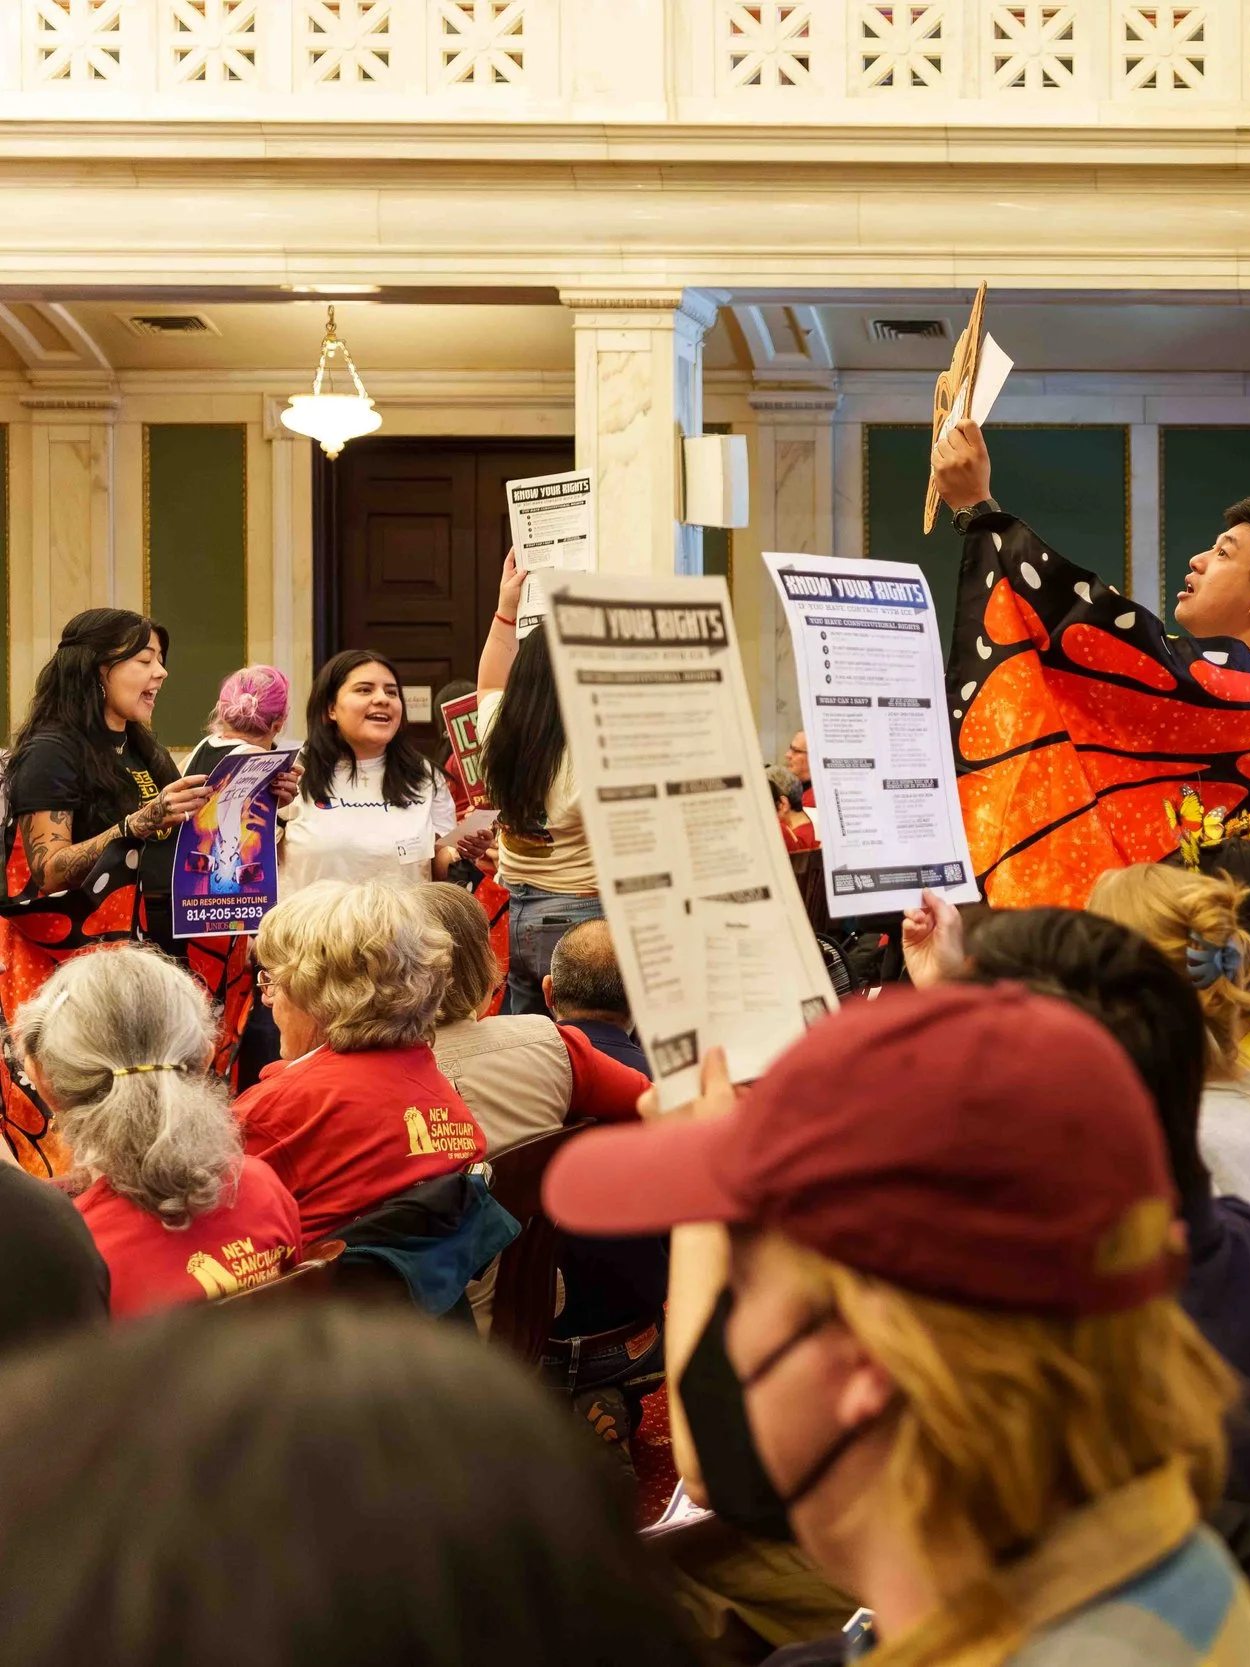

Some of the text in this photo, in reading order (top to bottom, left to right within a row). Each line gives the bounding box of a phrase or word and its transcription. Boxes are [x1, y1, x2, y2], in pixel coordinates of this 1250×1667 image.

[513, 479, 589, 502] KNOW YOUR RIGHTS
[783, 574, 924, 603] KNOW YOUR RIGHTS
[609, 608, 655, 640] YOUR
[655, 608, 725, 640] RIGHTS
[843, 619, 897, 630] CONSTITUTIONAL
[897, 623, 921, 631] RIGHTS
[217, 787, 250, 804] ICE
[182, 895, 268, 907] RAID RESPONSE HOTLINE
[186, 906, 263, 921] 814-205-3293
[429, 1108, 449, 1122] NEW
[431, 1122, 474, 1138] SANCTUARY
[431, 1137, 477, 1152] MOVEMENT
[221, 1236, 255, 1260] NEW
[231, 1245, 297, 1276] SANCTUARY
